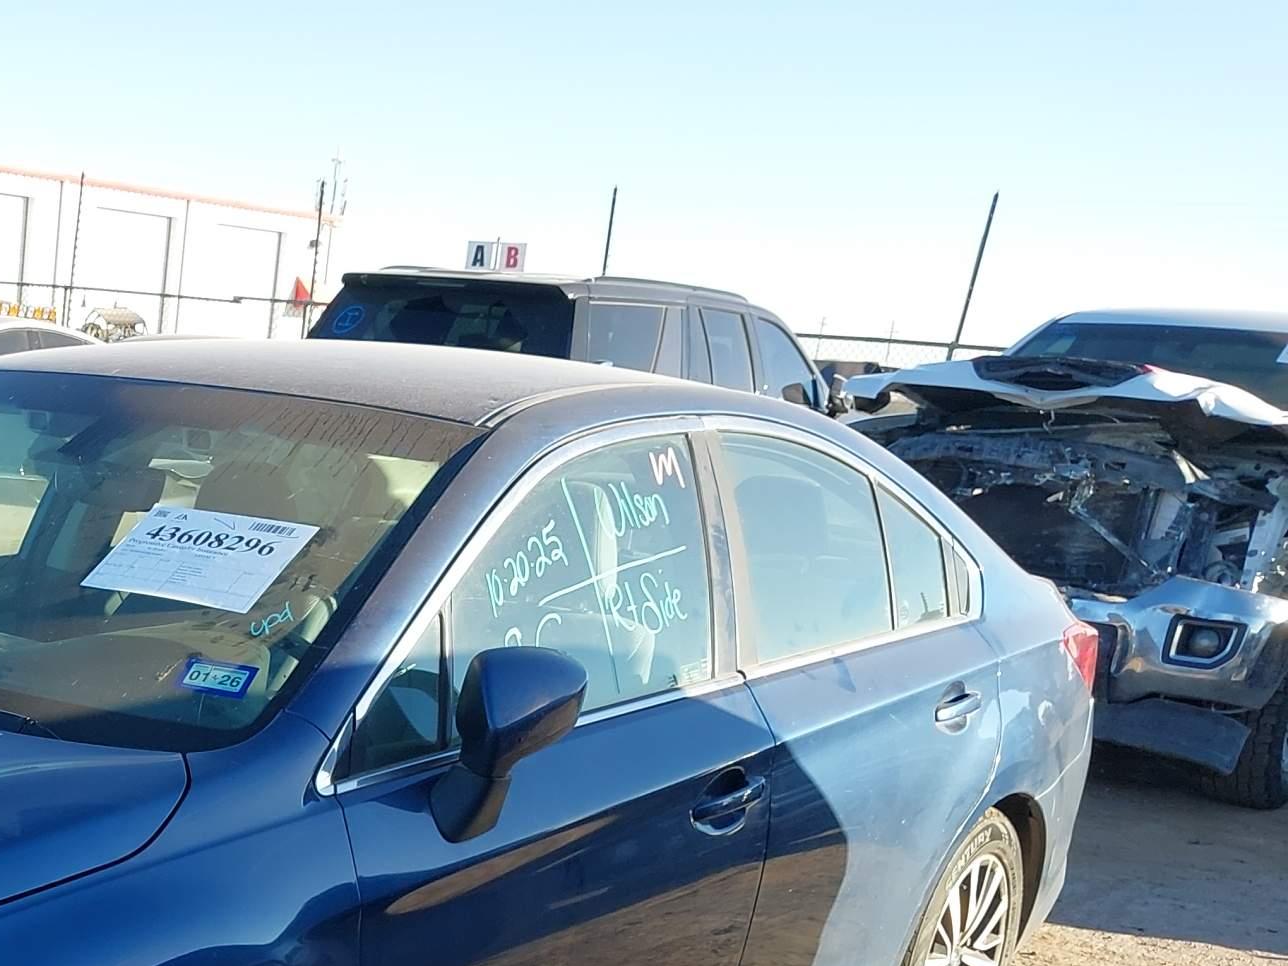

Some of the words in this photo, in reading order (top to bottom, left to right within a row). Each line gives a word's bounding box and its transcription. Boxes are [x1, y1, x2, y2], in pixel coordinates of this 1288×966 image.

[472, 245, 485, 267] A
[505, 246, 519, 268] B
[594, 481, 670, 537] Wilson
[145, 524, 283, 558] 43608296
[188, 670, 210, 683] 01
[217, 674, 242, 688] 26
